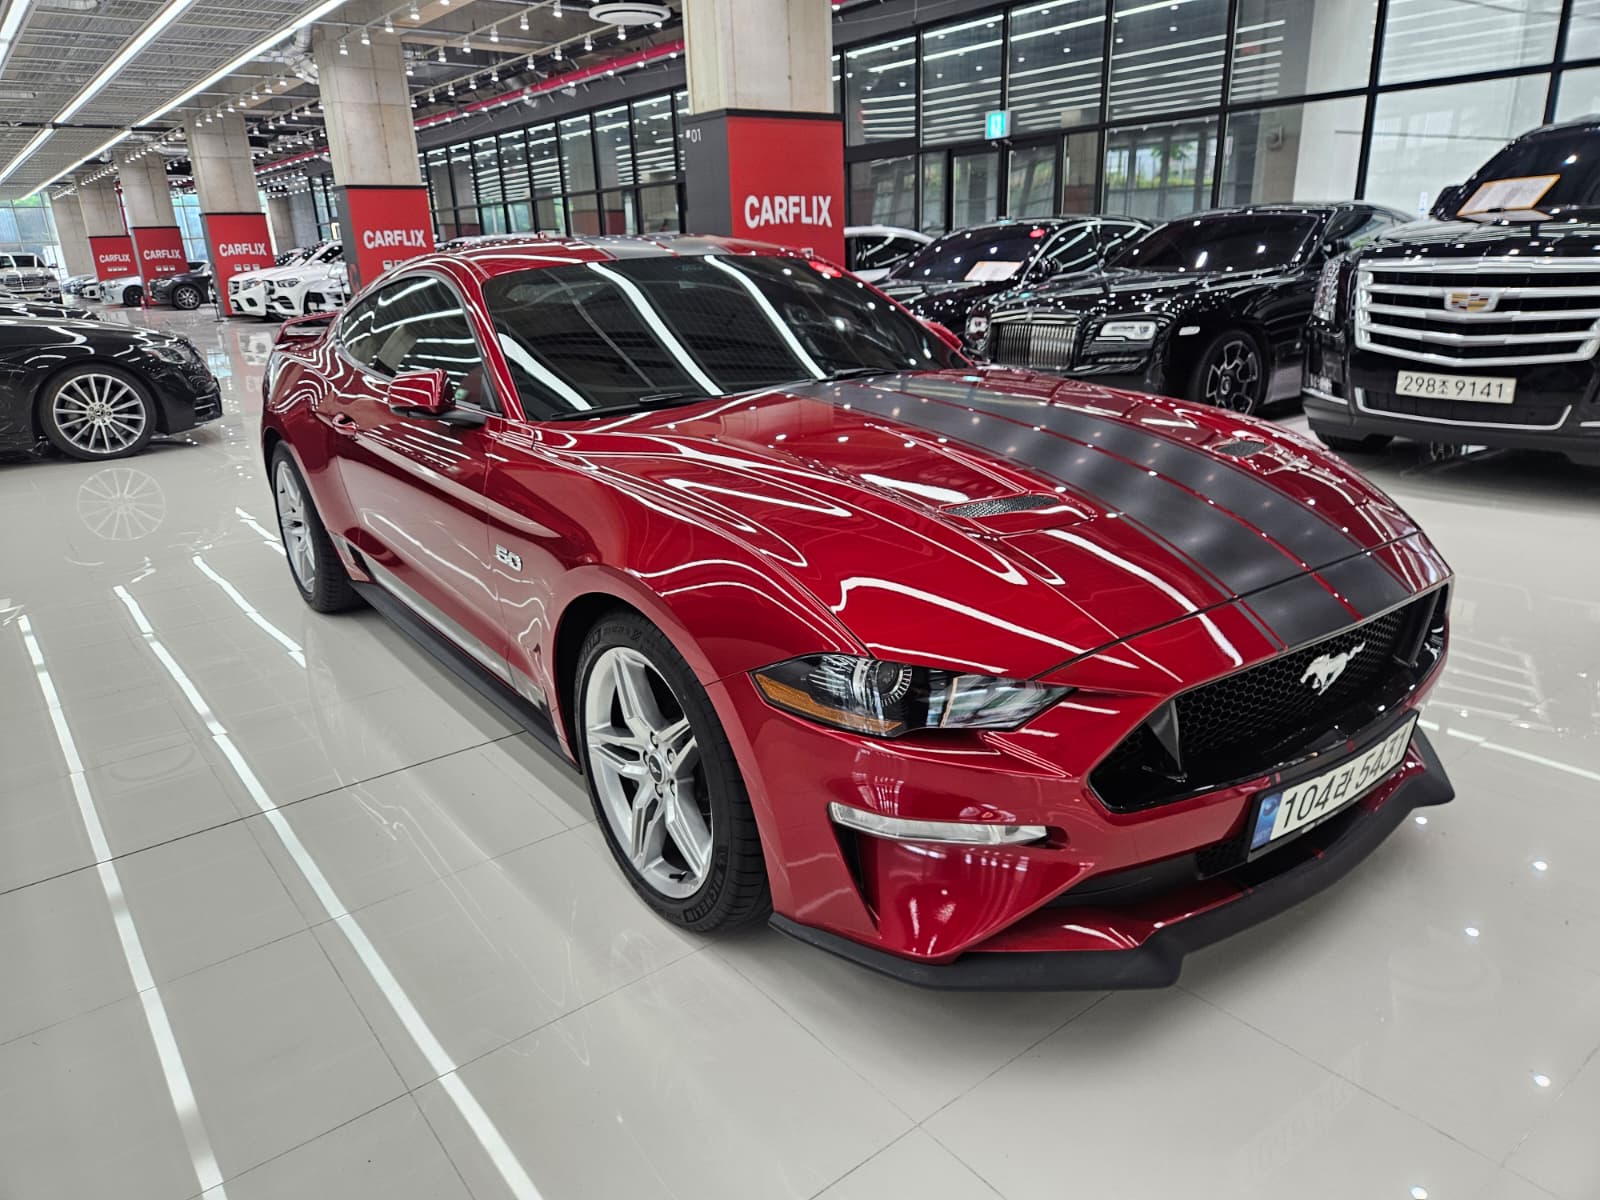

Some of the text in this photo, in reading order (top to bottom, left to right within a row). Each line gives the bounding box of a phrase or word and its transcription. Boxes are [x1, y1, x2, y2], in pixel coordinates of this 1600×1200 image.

[744, 194, 833, 229] CARFLIX
[363, 229, 427, 249] CARFLIX
[99, 253, 131, 263] CARFLIX
[143, 249, 181, 260] CARFLIX
[218, 243, 267, 257] CARFLIX
[1455, 380, 1503, 398] 9141
[1355, 726, 1408, 789] 5431
